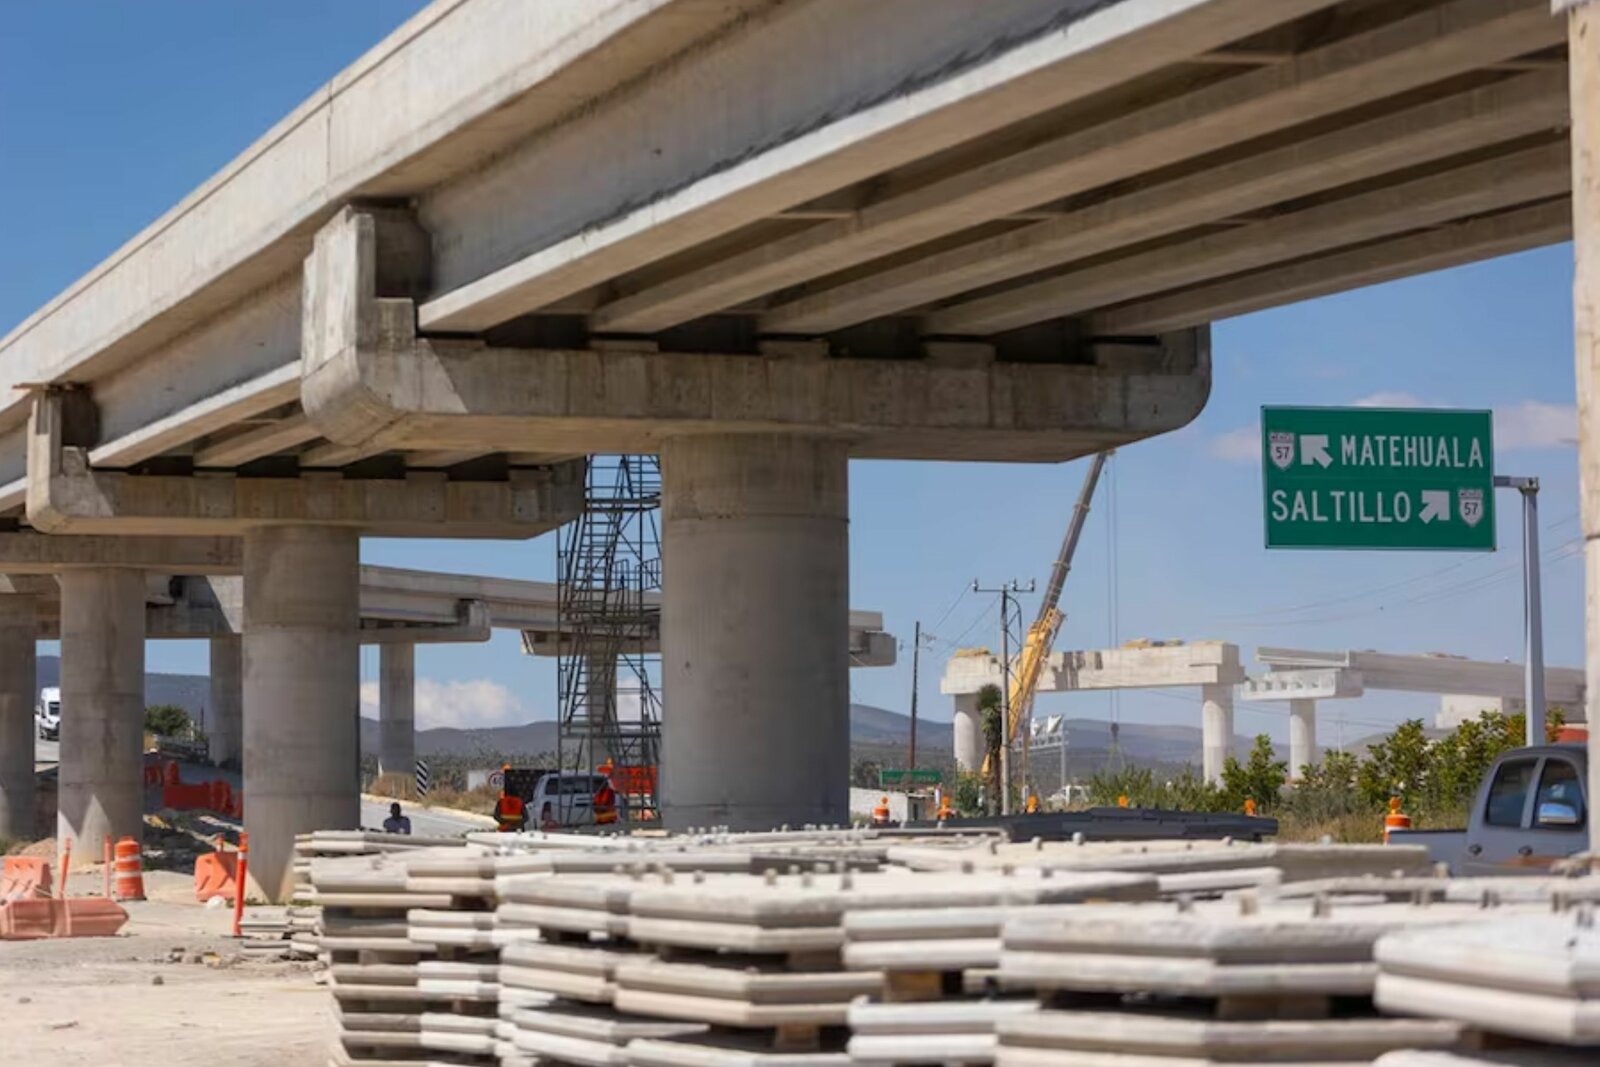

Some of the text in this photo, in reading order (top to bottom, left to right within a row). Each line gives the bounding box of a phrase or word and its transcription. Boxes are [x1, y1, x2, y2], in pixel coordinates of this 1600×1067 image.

[1275, 434, 1483, 468] 57 MATEHUALA
[1272, 489, 1479, 523] SALTILLO 57
